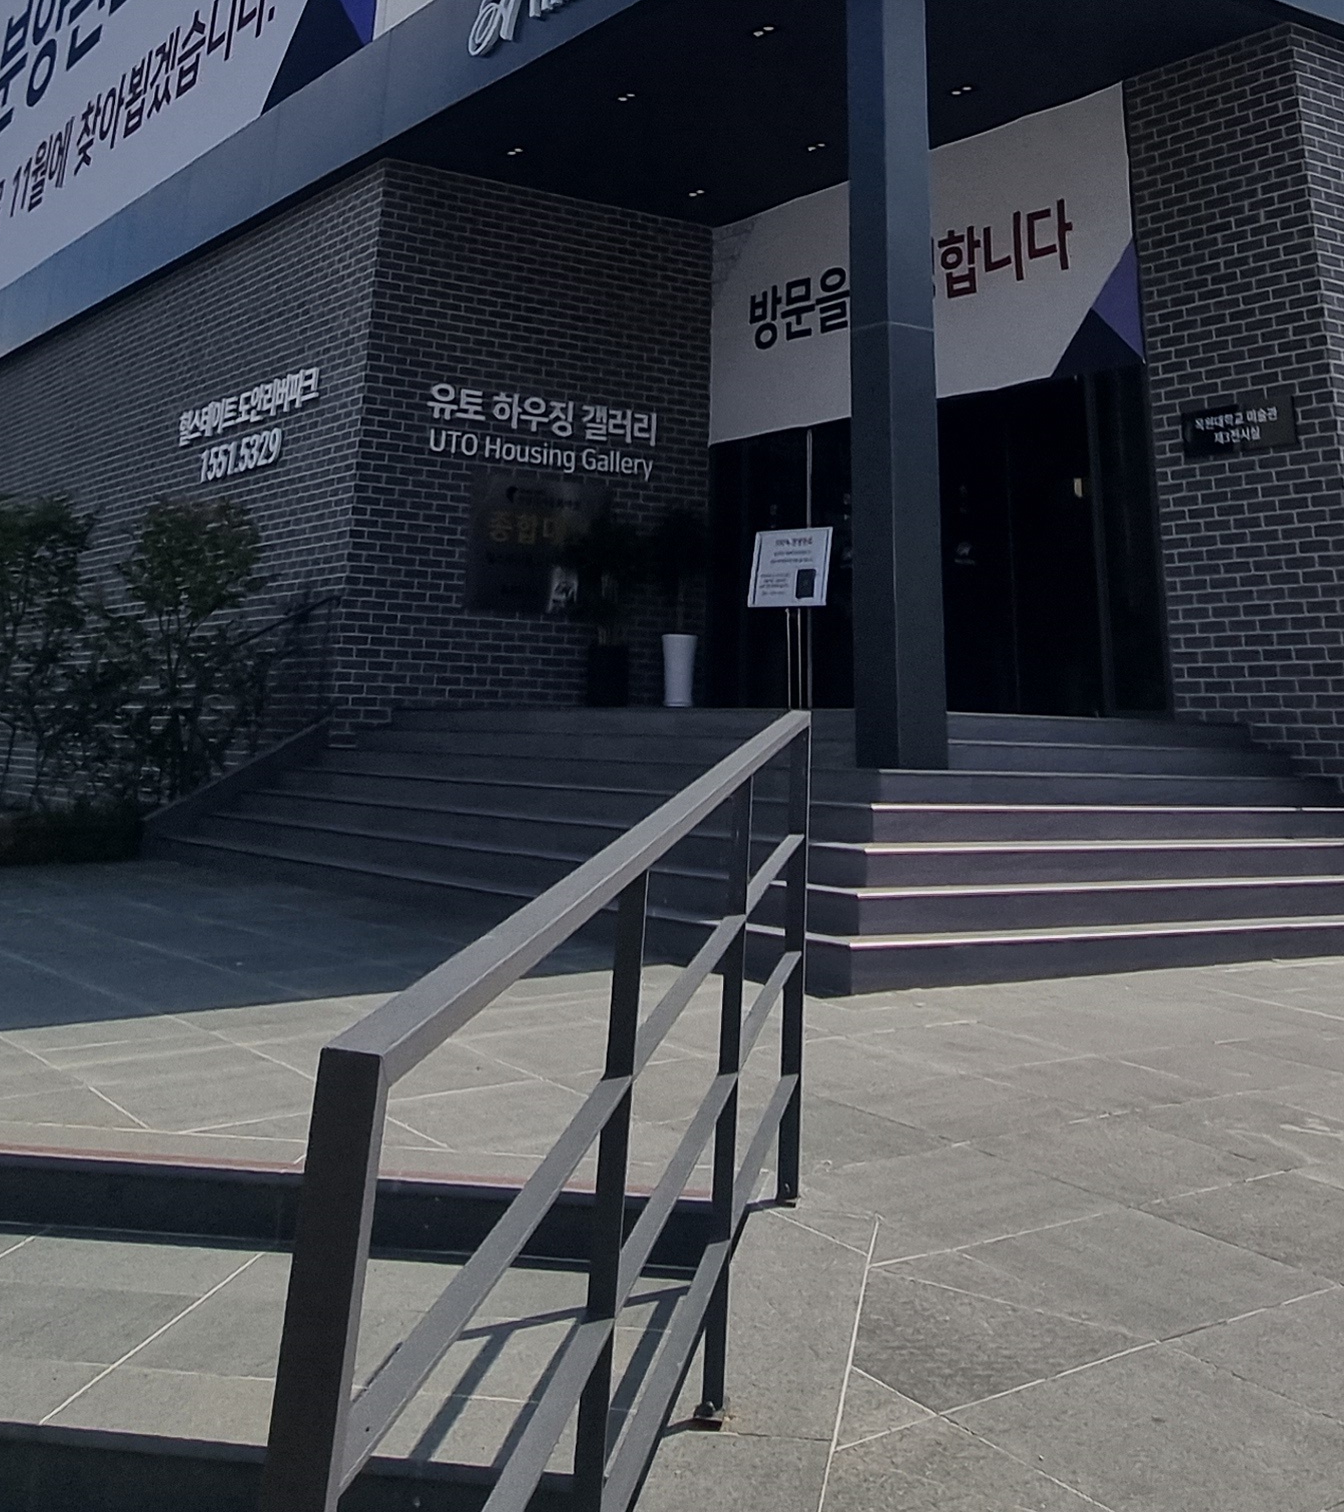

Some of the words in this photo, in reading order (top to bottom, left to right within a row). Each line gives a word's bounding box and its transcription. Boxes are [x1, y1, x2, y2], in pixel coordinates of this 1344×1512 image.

[9, 116, 75, 218] 11월에
[749, 266, 851, 351] 방문을
[930, 197, 1074, 300] 합니다
[426, 382, 486, 422] 유토
[492, 391, 574, 438] 하우징
[581, 404, 657, 447] 갤러리
[200, 427, 283, 484] 1551.5329
[429, 428, 479, 457] UTO
[484, 435, 576, 474] Housing
[582, 448, 654, 482] Gallery
